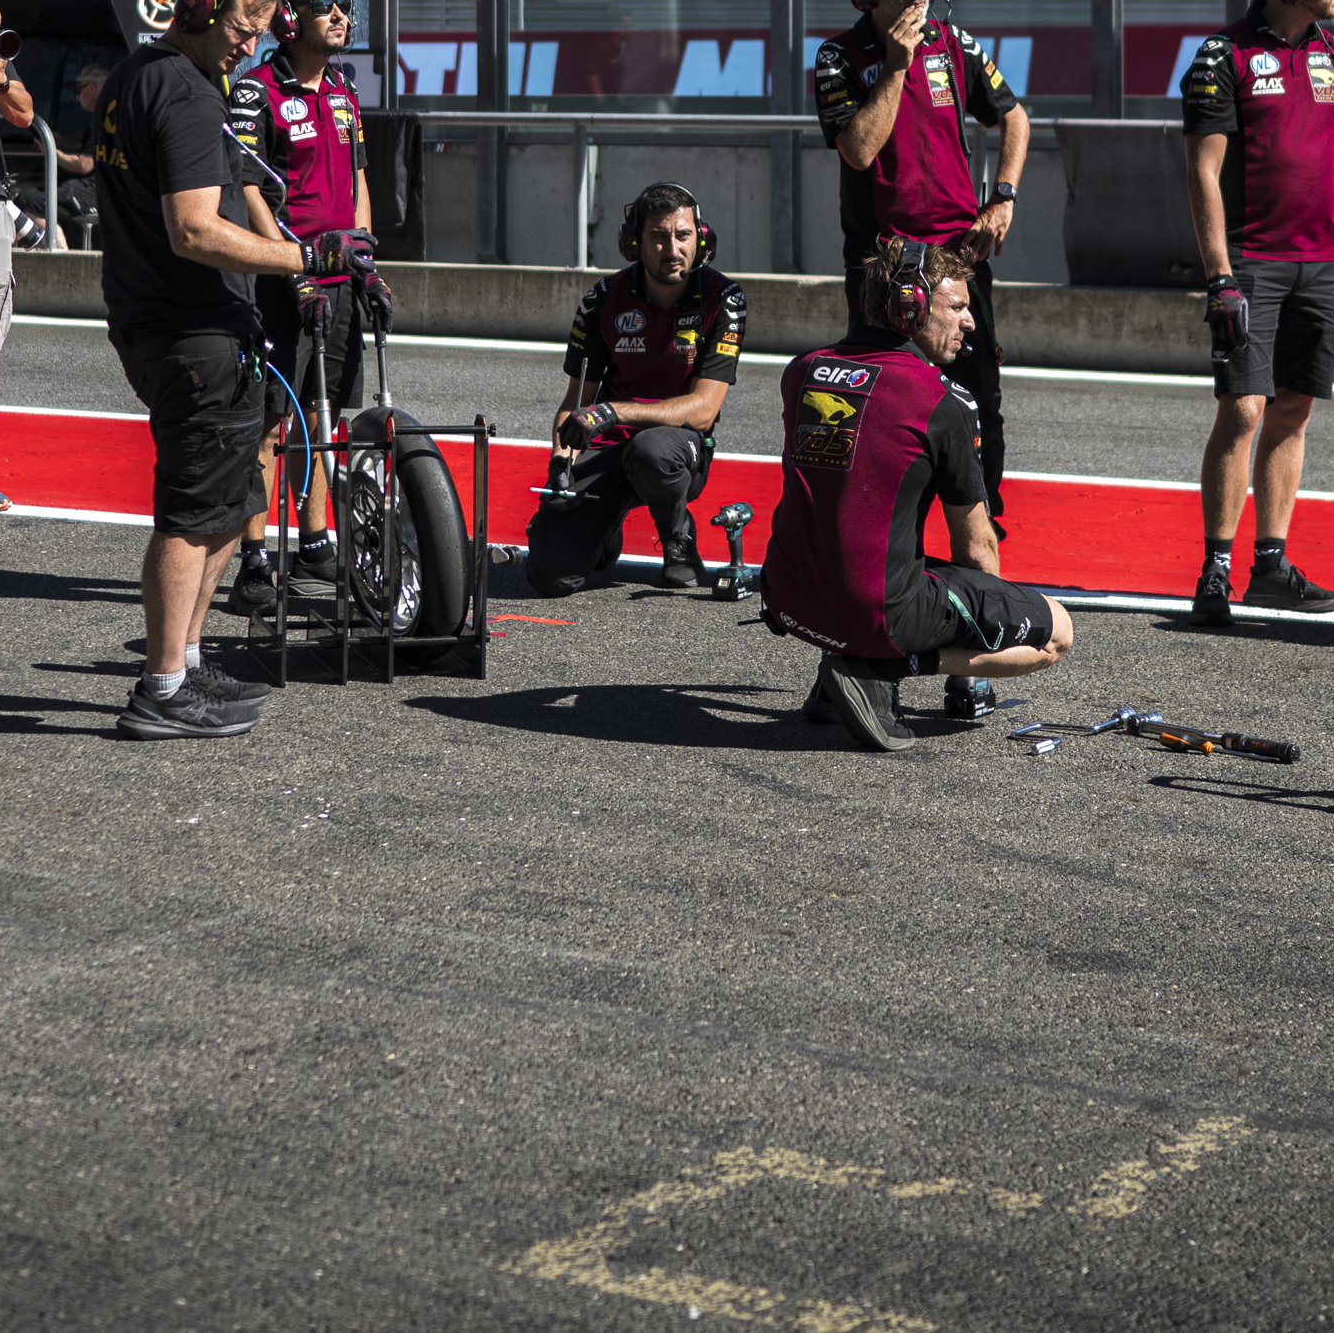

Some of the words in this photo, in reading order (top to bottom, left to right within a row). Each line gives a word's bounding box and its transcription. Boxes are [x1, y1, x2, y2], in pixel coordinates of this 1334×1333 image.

[820, 80, 832, 91] elf
[1252, 77, 1283, 90] MAX
[290, 122, 315, 137] MAX
[678, 316, 695, 326] elf
[616, 337, 645, 347] MAX
[813, 366, 849, 383] elf
[791, 453, 819, 462] RACING
[824, 458, 847, 466] TEAM
[797, 625, 847, 649] IXON
